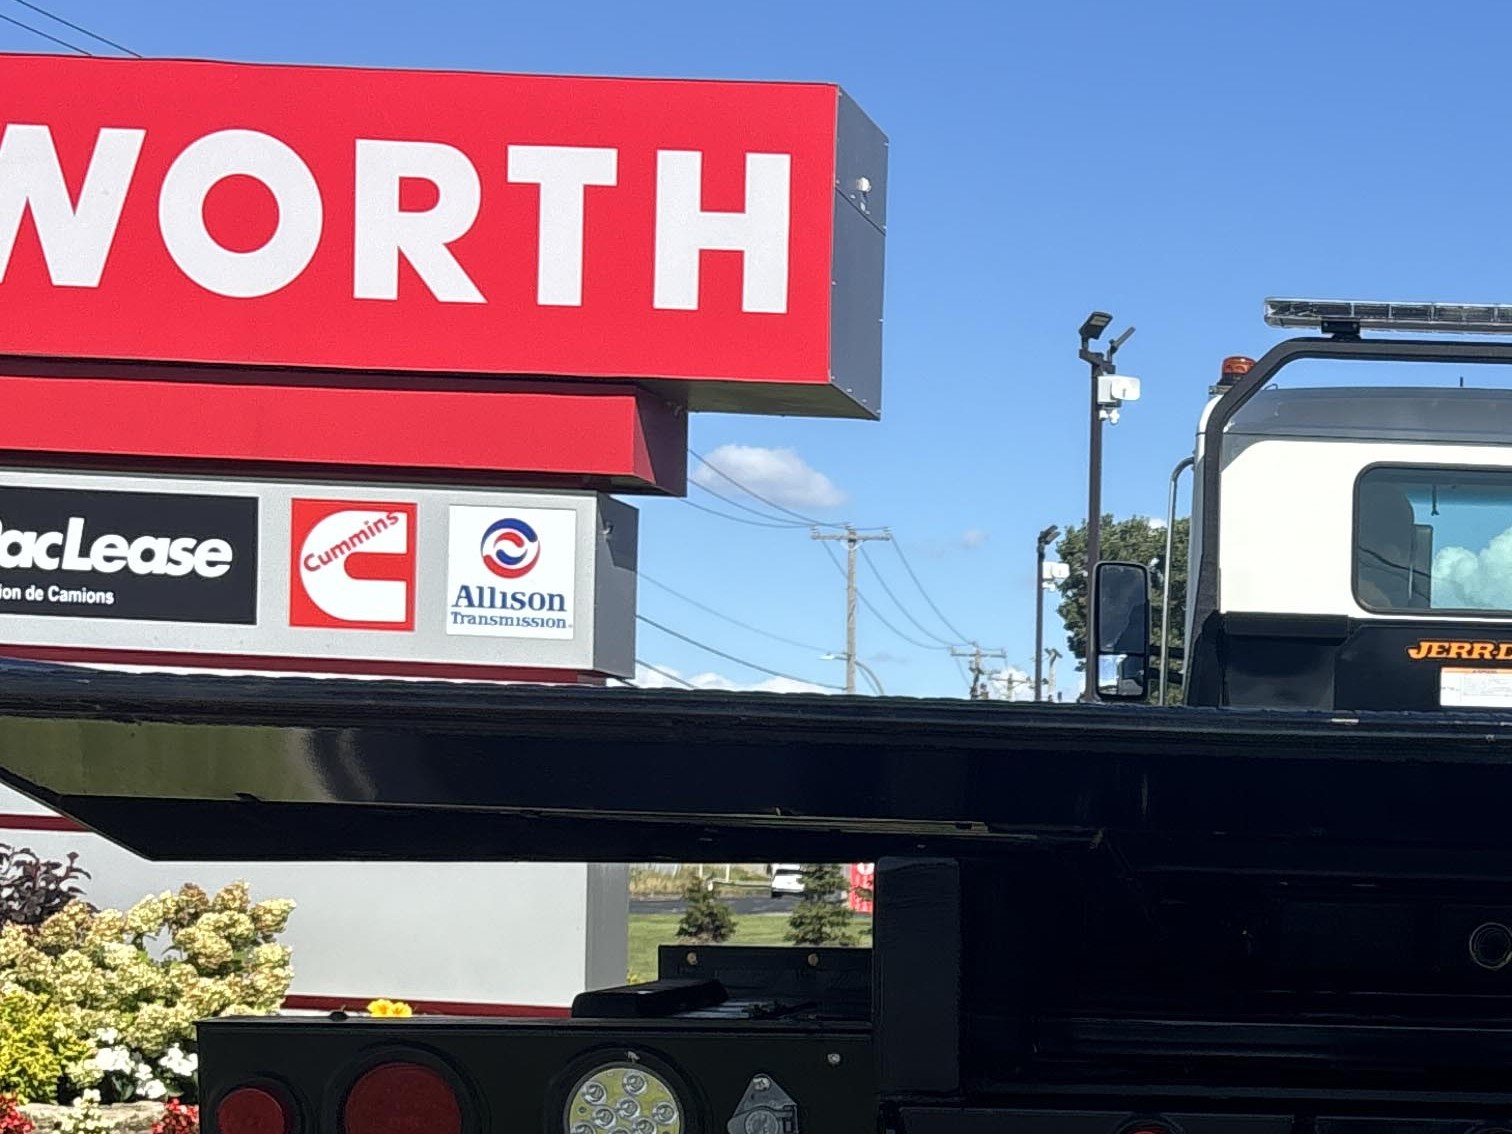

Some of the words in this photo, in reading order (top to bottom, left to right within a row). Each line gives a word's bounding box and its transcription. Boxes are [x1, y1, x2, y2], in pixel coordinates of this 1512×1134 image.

[0, 124, 792, 314] WORTH
[0, 516, 234, 578] acLease
[303, 511, 400, 573] Cummins
[25, 585, 44, 602] de
[48, 585, 115, 605] Camions
[451, 584, 568, 613] Allison
[451, 611, 568, 629] Transmission
